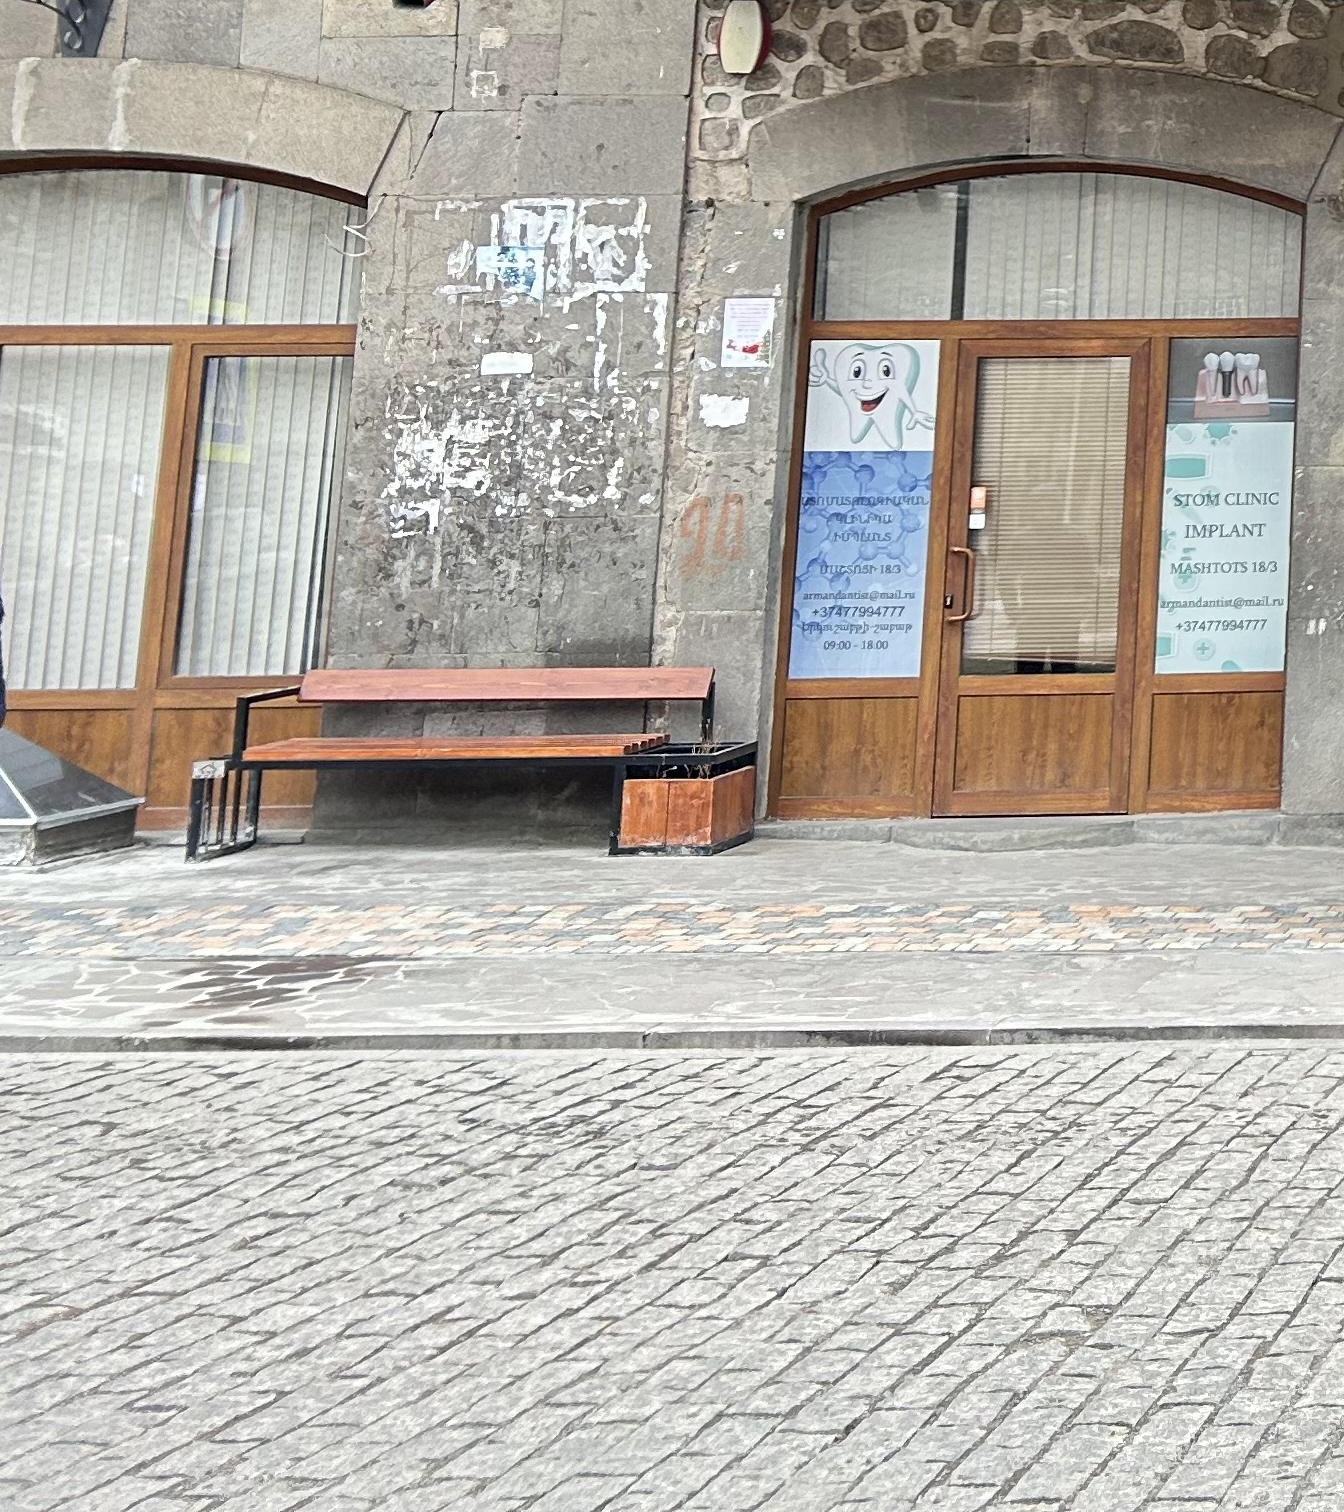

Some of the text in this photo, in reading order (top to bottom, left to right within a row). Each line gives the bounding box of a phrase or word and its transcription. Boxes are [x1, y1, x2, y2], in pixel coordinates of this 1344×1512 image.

[1173, 492, 1280, 507] STOM CLINIC
[1184, 524, 1266, 538] IMPLANT
[1170, 561, 1278, 575] MASHTOTS 18/3
